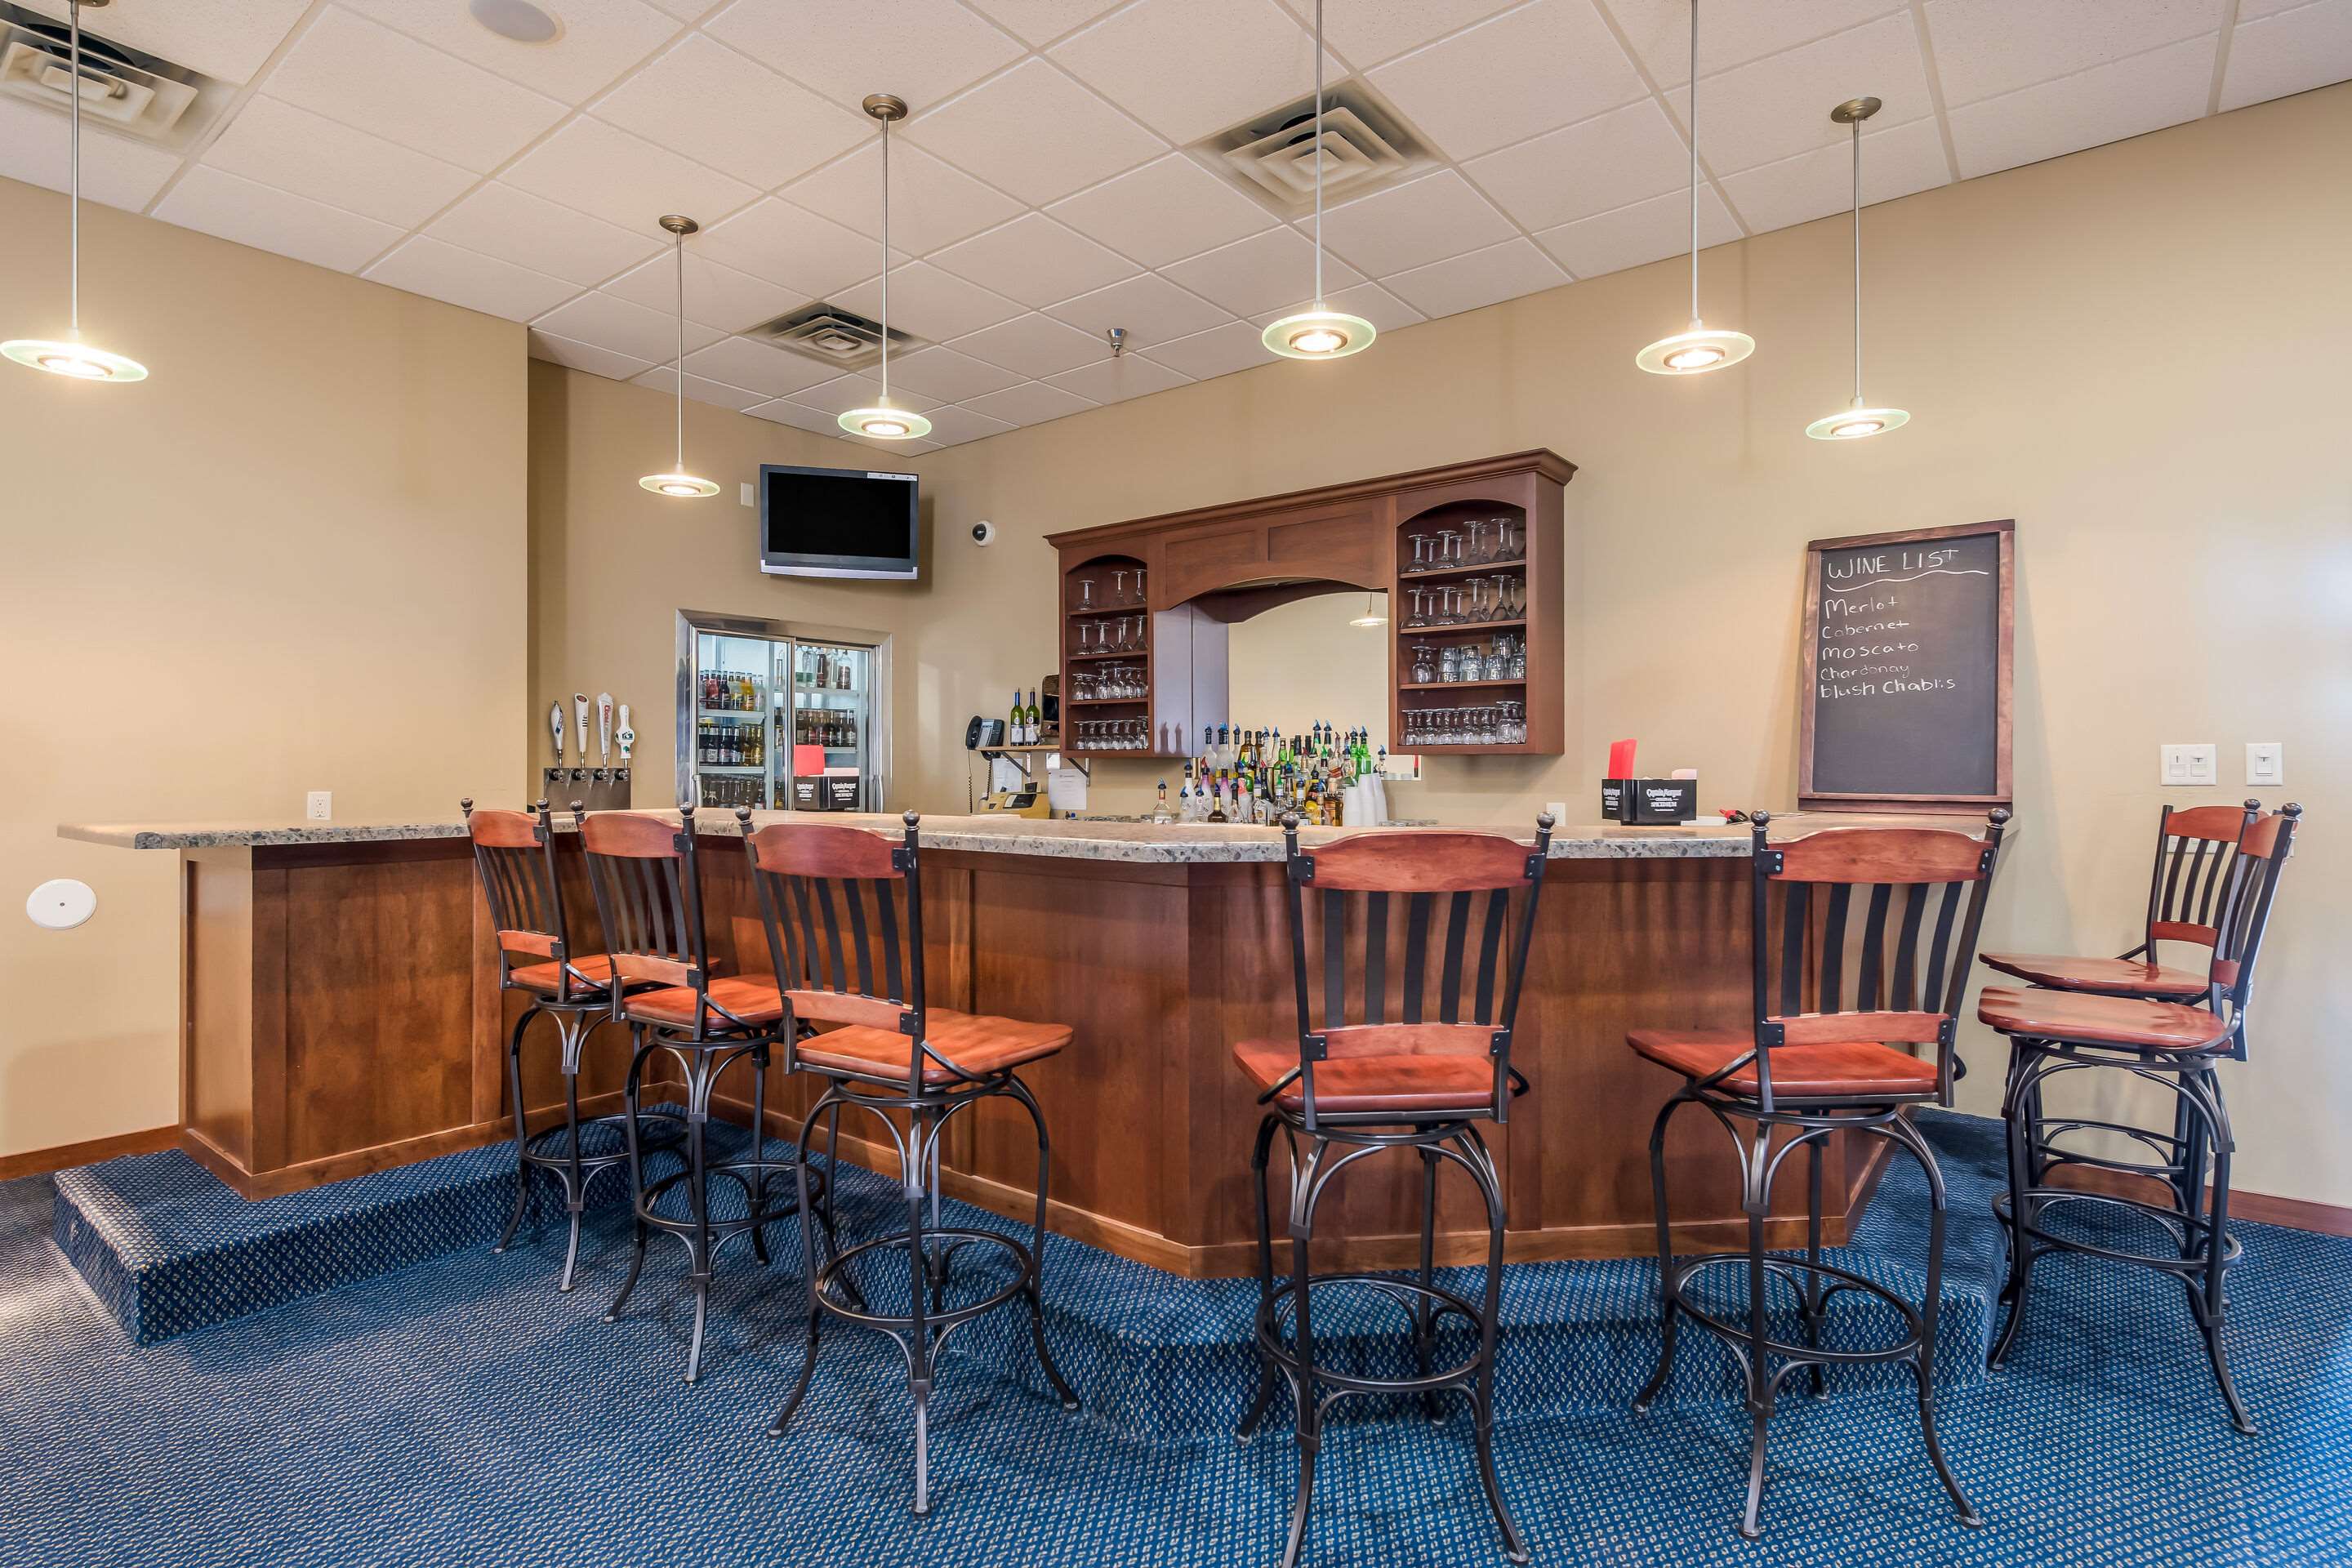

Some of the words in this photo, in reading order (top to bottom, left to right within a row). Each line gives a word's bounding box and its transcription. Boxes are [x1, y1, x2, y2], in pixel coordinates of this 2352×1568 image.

[1828, 555, 1891, 579] WINE
[1902, 549, 1959, 570] LIST
[1824, 595, 1899, 619] Merlot
[1822, 620, 1910, 639] Cabernet
[1882, 679, 1956, 694] Chablis
